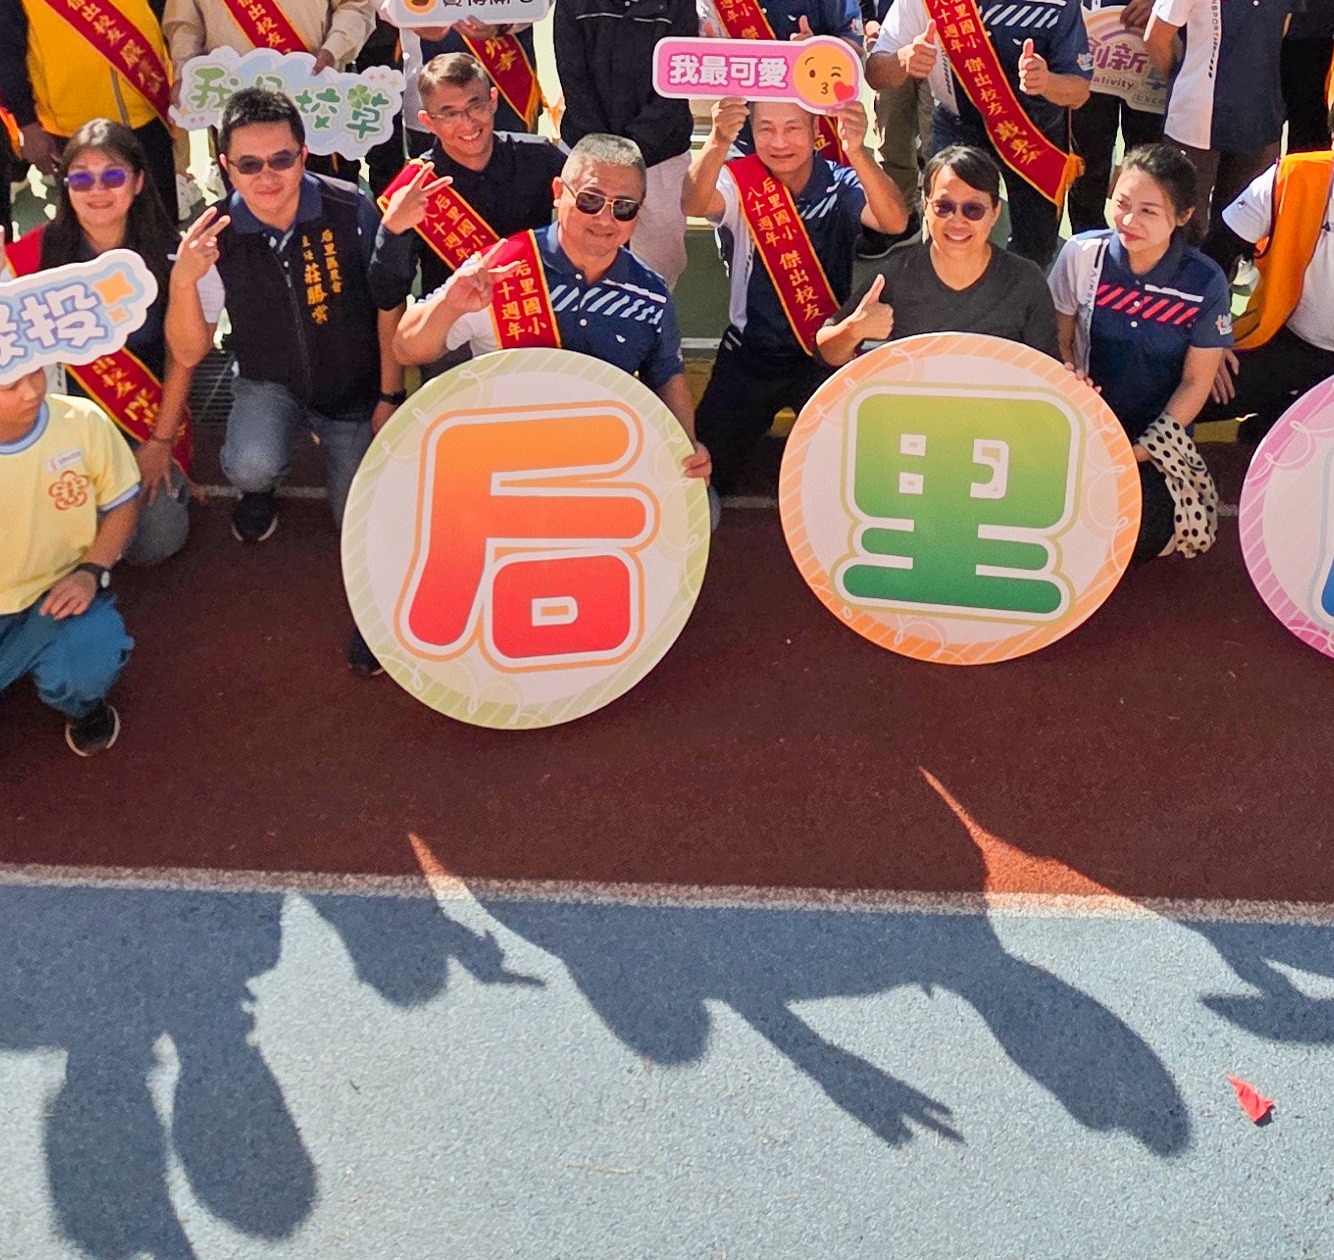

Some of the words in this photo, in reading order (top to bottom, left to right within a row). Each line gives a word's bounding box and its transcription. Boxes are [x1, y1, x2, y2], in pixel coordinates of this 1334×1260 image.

[190, 67, 390, 139] 我校草
[669, 55, 787, 88] 我最可愛
[746, 186, 780, 247] 八十週年
[762, 177, 798, 241] 后里國小
[515, 259, 547, 335] 后里國小
[779, 250, 826, 322] 傑出校友
[408, 413, 647, 660] 后
[843, 393, 1078, 615] 里
